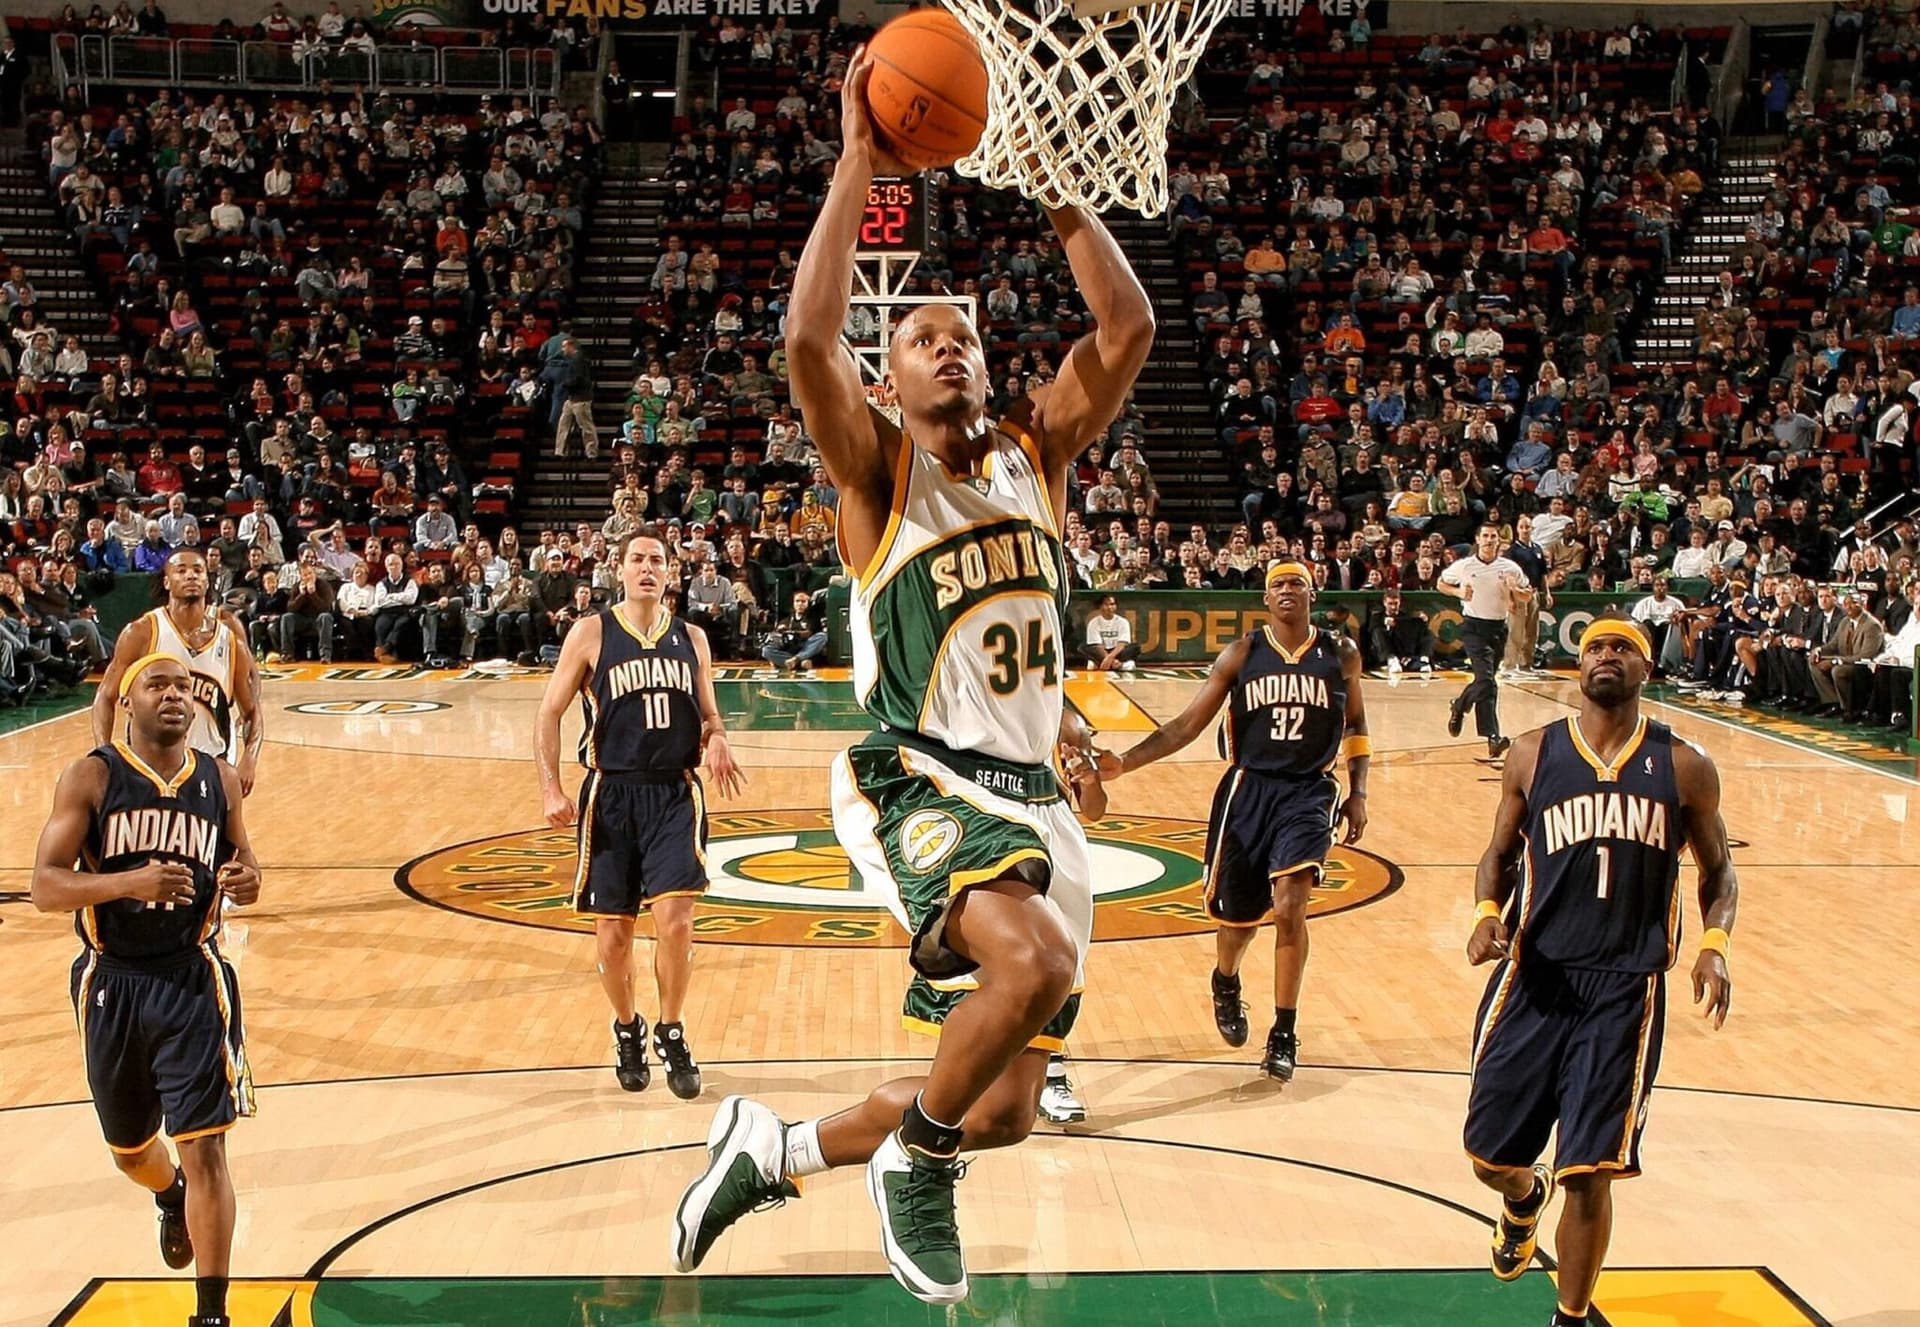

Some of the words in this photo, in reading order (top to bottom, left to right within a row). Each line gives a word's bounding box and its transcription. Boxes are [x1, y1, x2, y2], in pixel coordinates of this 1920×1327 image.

[483, 0, 538, 13] OUR
[546, 0, 646, 19] FANS
[653, 0, 706, 15] ARE
[714, 0, 761, 15] THE
[768, 0, 820, 15] KEY
[1263, 0, 1303, 17] TH
[868, 185, 913, 205] 6:05
[862, 206, 905, 244] 22
[981, 617, 1059, 697] 34
[609, 657, 694, 701] INDIANA
[1245, 673, 1330, 712] INDIANA
[641, 692, 671, 730] 10
[1270, 706, 1305, 741] 32
[975, 769, 1024, 793] SEATTLE
[104, 807, 219, 873] INDIANA
[1543, 792, 1667, 856] INDIANA
[1595, 845, 1611, 899] 1
